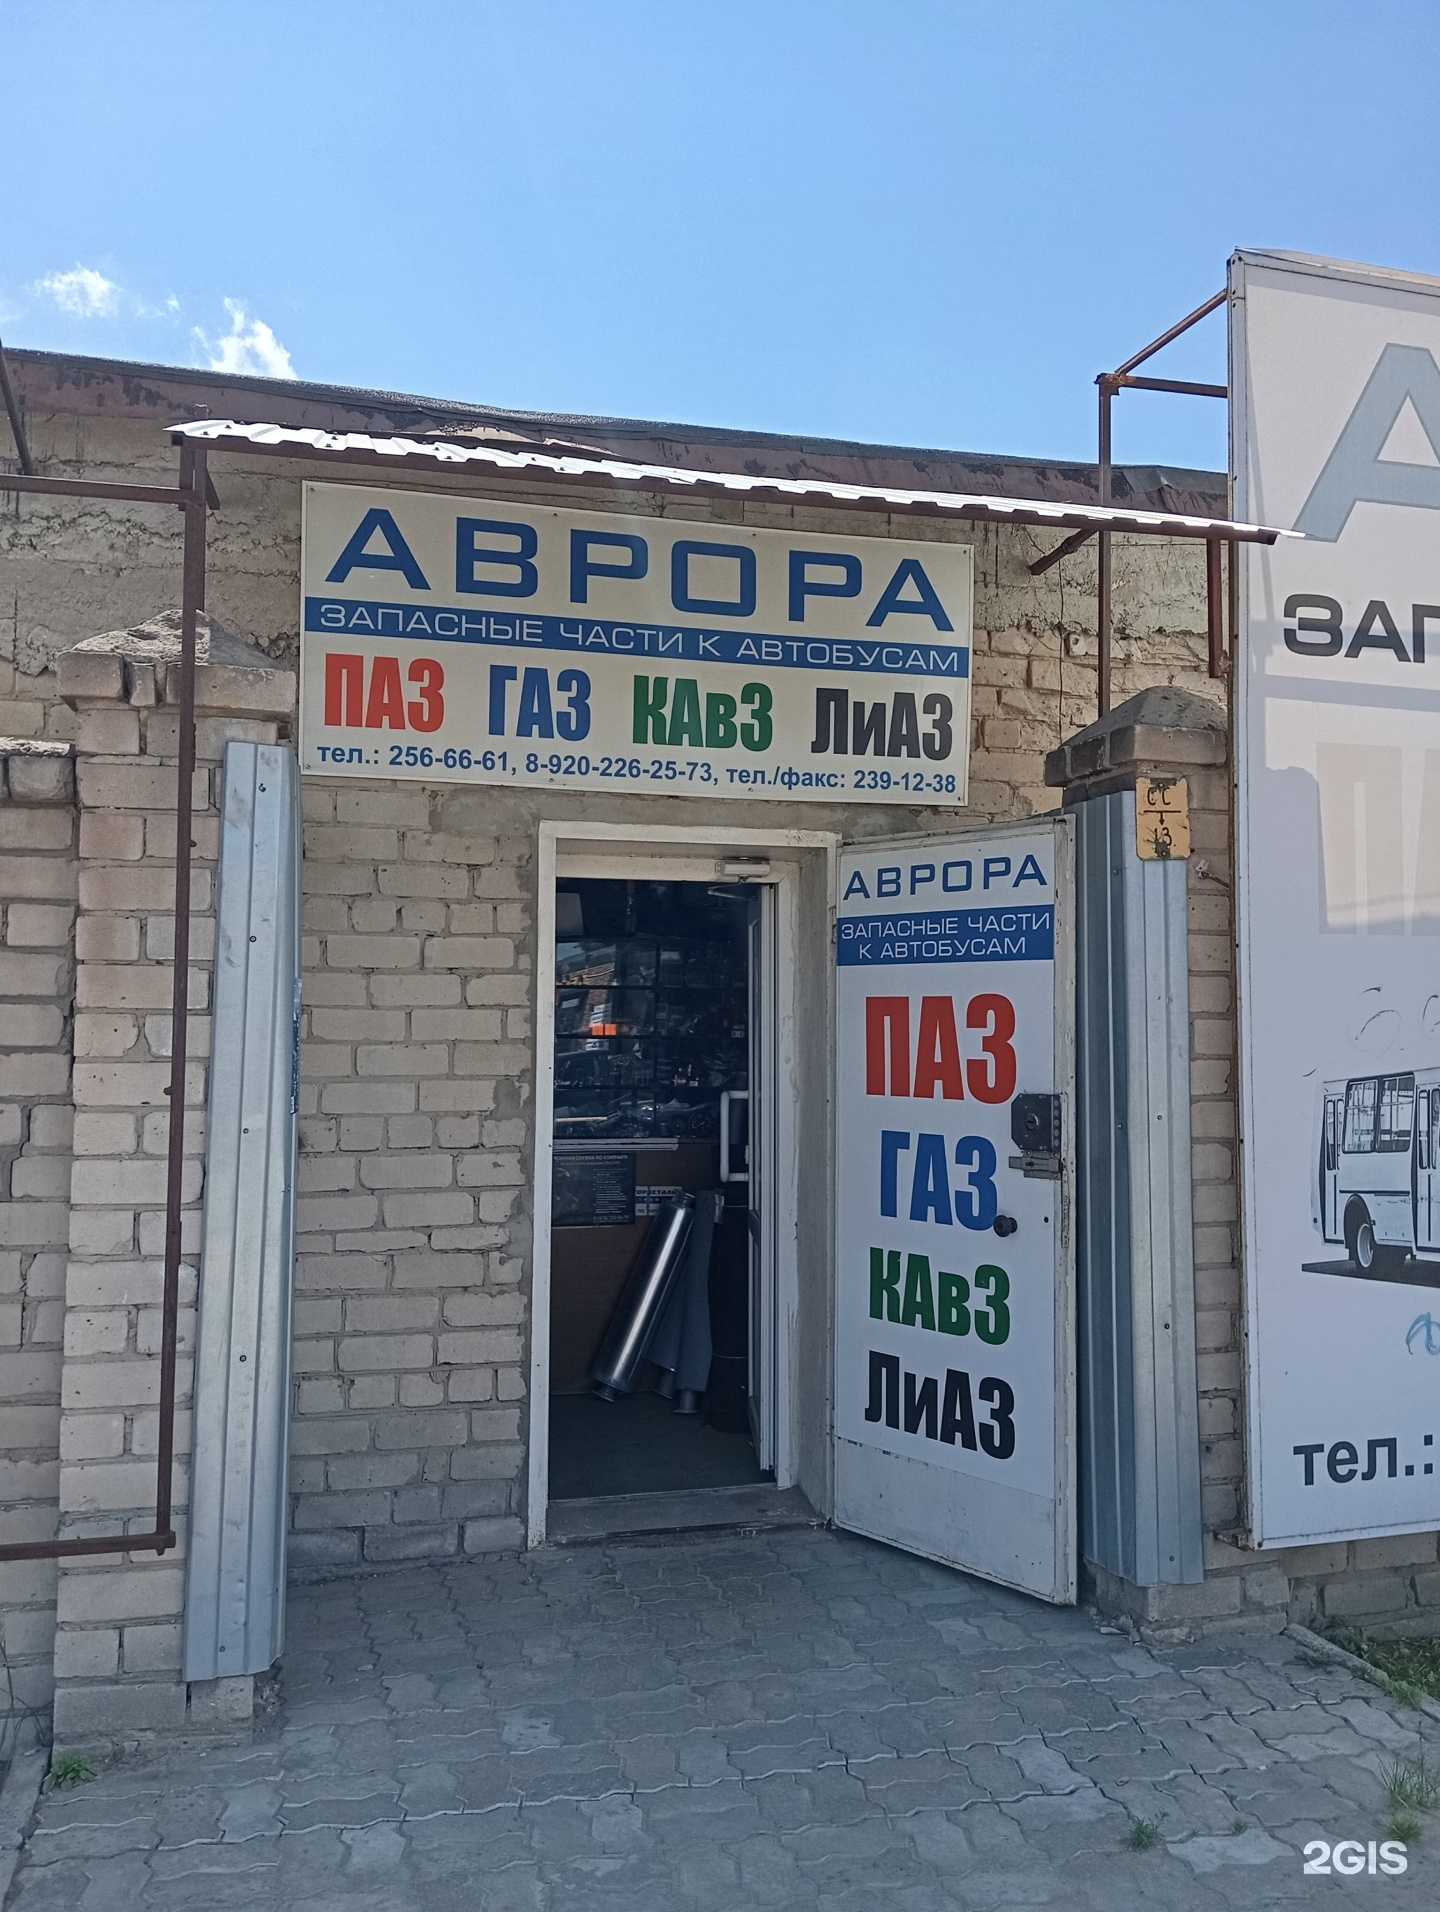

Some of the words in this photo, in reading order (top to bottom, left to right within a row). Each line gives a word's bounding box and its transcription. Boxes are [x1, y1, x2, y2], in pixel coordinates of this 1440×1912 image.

[325, 508, 954, 632] АВРОРА
[320, 604, 543, 642] ЗАПАСНЫЕ
[559, 623, 683, 653] ЧАСТИ
[698, 634, 721, 656] К
[736, 638, 958, 672] АВТОБУСАМ
[324, 653, 444, 732] ПАЗ
[488, 664, 591, 741] ГАЗ
[632, 674, 773, 752] КАвЗ
[811, 687, 952, 760] ЛиАЗ
[317, 745, 379, 765] тел.:
[388, 745, 517, 776] 256-66-61,
[525, 753, 718, 785] 8-920-226-25-73,
[726, 766, 846, 790] тел./факс:
[853, 770, 956, 793] 239-12-38
[843, 854, 1048, 900] АВРОРА
[841, 917, 958, 939] ЗАПАСНЫЕ
[967, 912, 1050, 933] ЧАСТИ
[859, 943, 872, 959] К
[880, 937, 1026, 959] АВТОБУСАМ
[865, 994, 1017, 1104] ПАЗ
[880, 1130, 998, 1231] ГАЗ
[869, 1247, 1010, 1345] КАвЗ
[865, 1350, 1016, 1460] ЛиАЗ
[1292, 1433, 1433, 1486] тел.:
